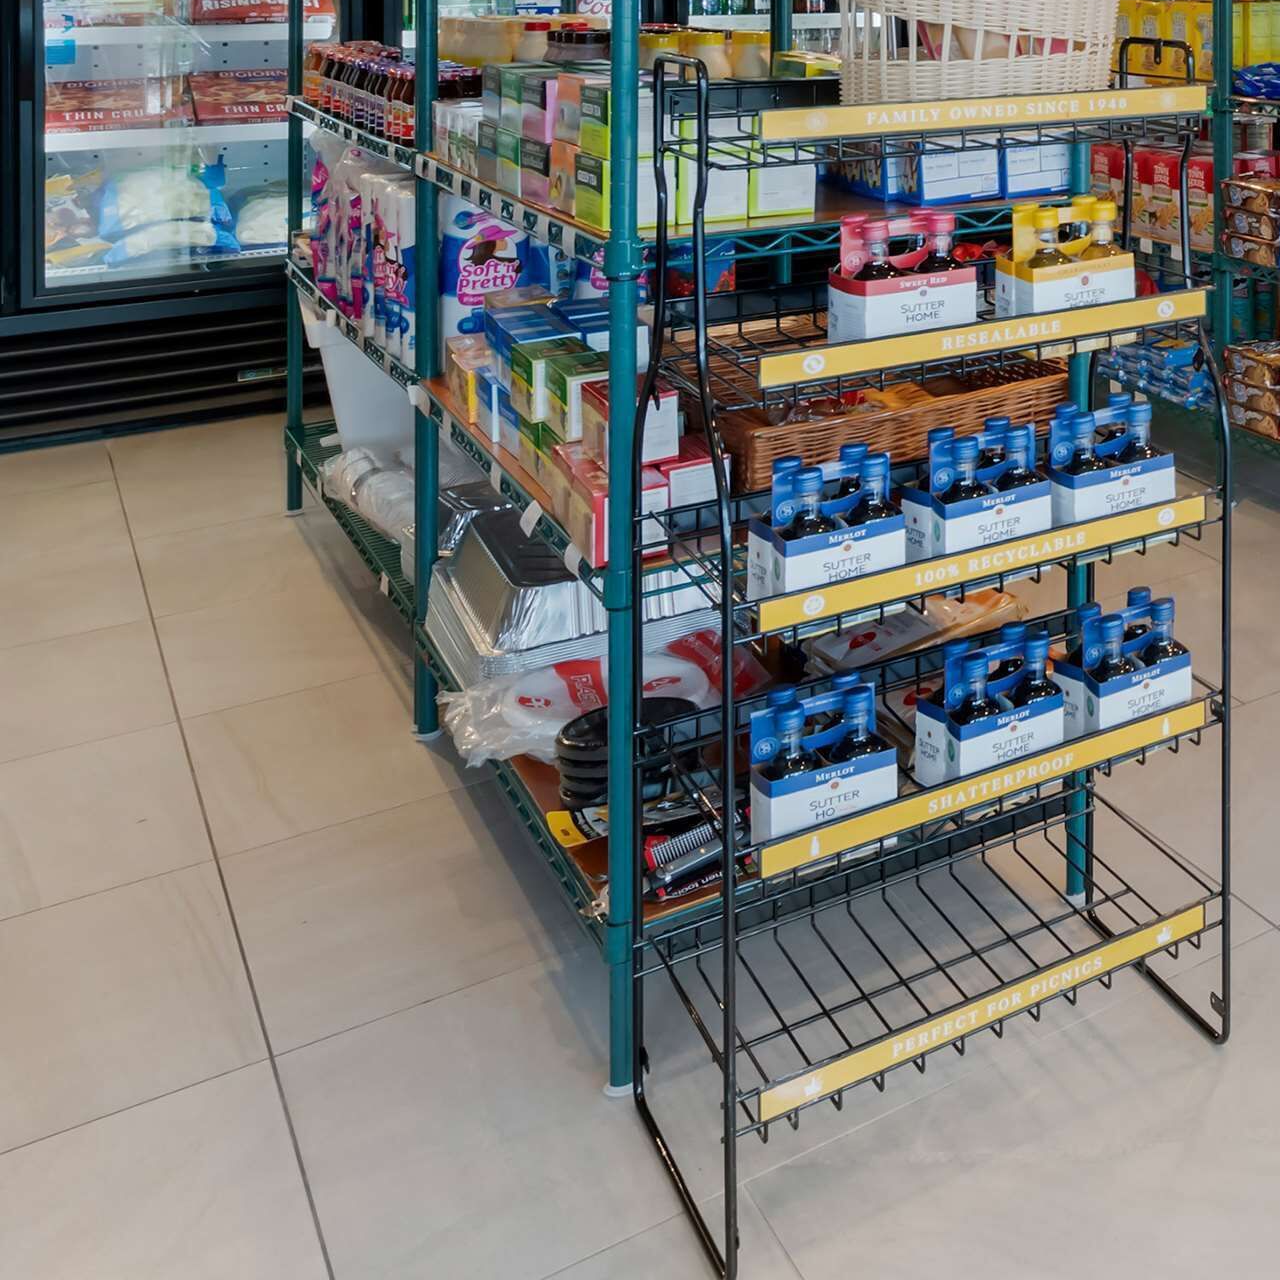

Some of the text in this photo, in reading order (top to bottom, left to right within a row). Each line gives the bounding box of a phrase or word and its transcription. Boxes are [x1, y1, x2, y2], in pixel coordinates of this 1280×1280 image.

[219, 71, 288, 79] DIGIORN
[64, 111, 104, 121] THIN
[223, 105, 260, 113] THIN
[867, 108, 941, 126] FAMILY
[950, 103, 1018, 120] OWNED
[1026, 99, 1079, 115] SINCE
[461, 259, 500, 278] Soft
[1064, 287, 1106, 303] SUTTER
[900, 299, 945, 314] SUTTER
[905, 311, 942, 323] HOME
[941, 320, 1062, 351] RESEALABLE
[1105, 486, 1147, 503] SUTTER
[1111, 496, 1143, 512] HOME
[977, 516, 1021, 534] SUTTER
[983, 527, 1017, 543] HOME
[823, 553, 871, 572] SUTTER
[915, 532, 1086, 585] 100% RECYCLABLE
[828, 564, 866, 583] HOME
[1127, 689, 1165, 708] SUTTER
[992, 731, 1035, 753] SUTTER
[997, 743, 1030, 761] HOME
[927, 752, 1075, 814] SHATTERPROOF
[809, 789, 860, 812] SUTTER
[892, 956, 1103, 1059] PERFECT FOR PICNICS
